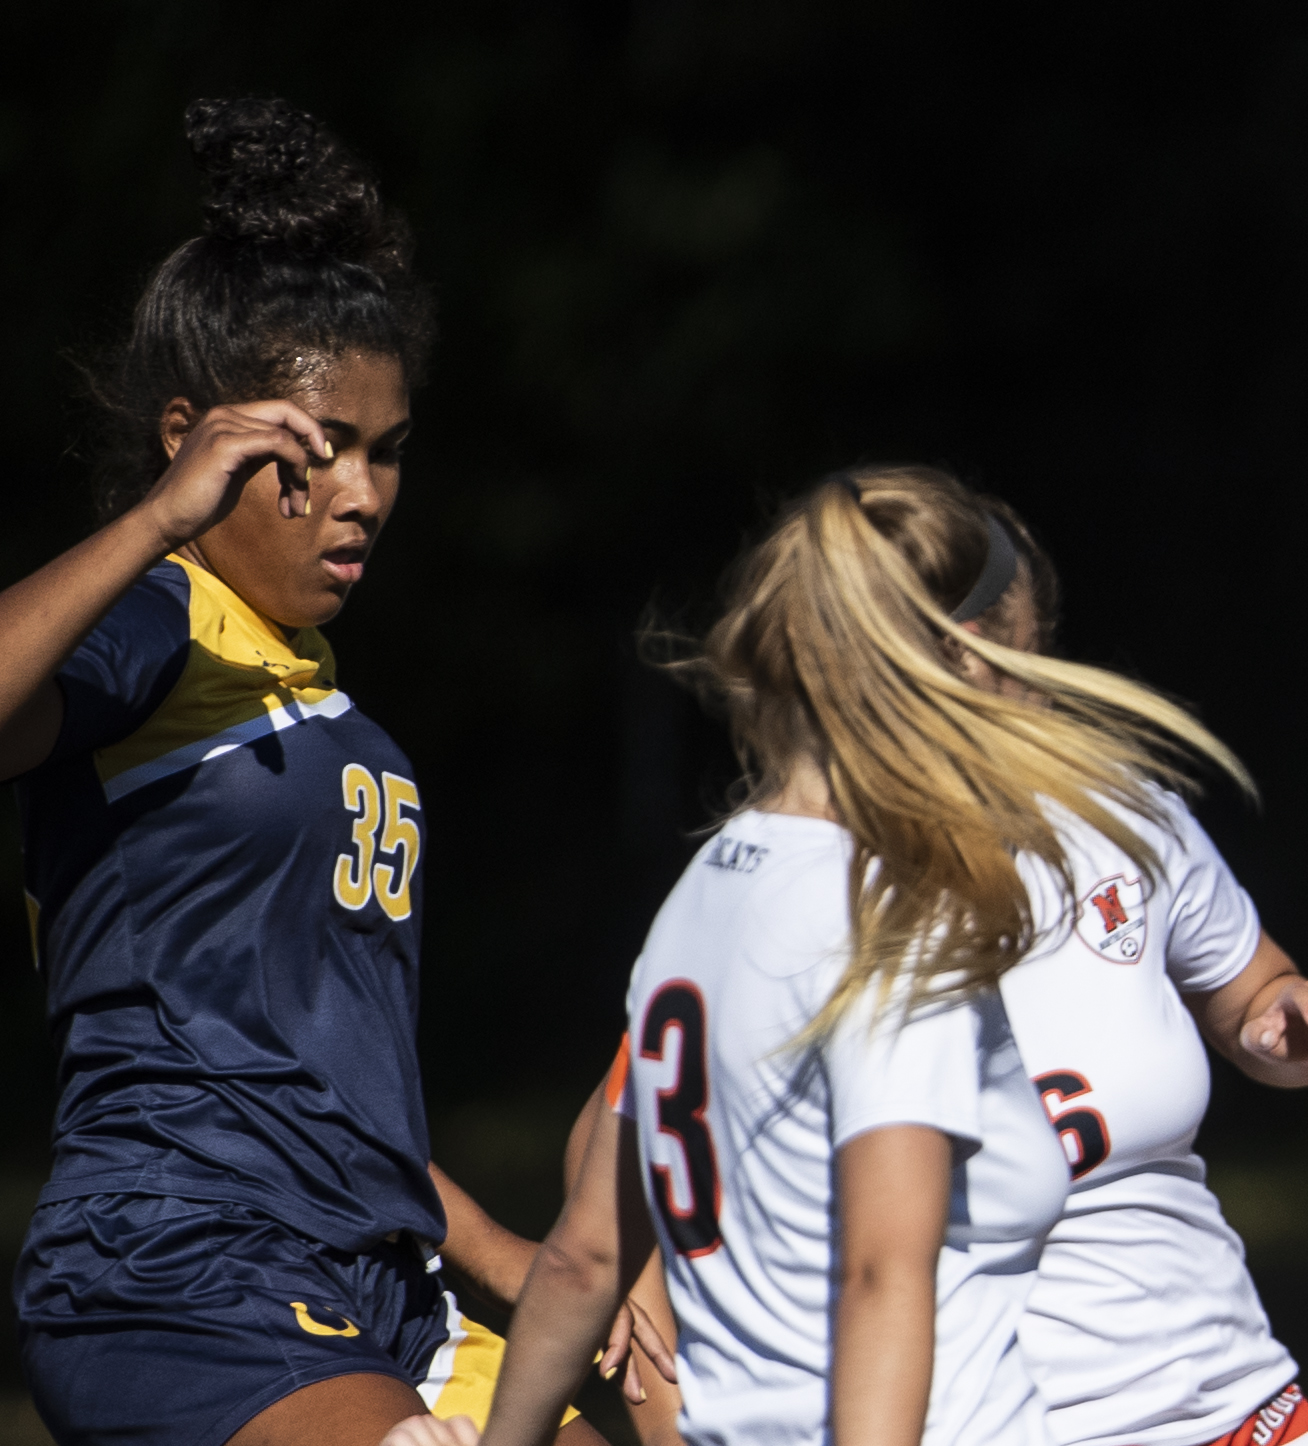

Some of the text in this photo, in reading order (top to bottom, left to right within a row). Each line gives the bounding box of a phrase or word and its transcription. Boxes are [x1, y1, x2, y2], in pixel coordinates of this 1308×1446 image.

[333, 763, 421, 921] 35
[1090, 883, 1128, 934] N
[638, 976, 722, 1258] 3
[1031, 1068, 1112, 1182] 6
